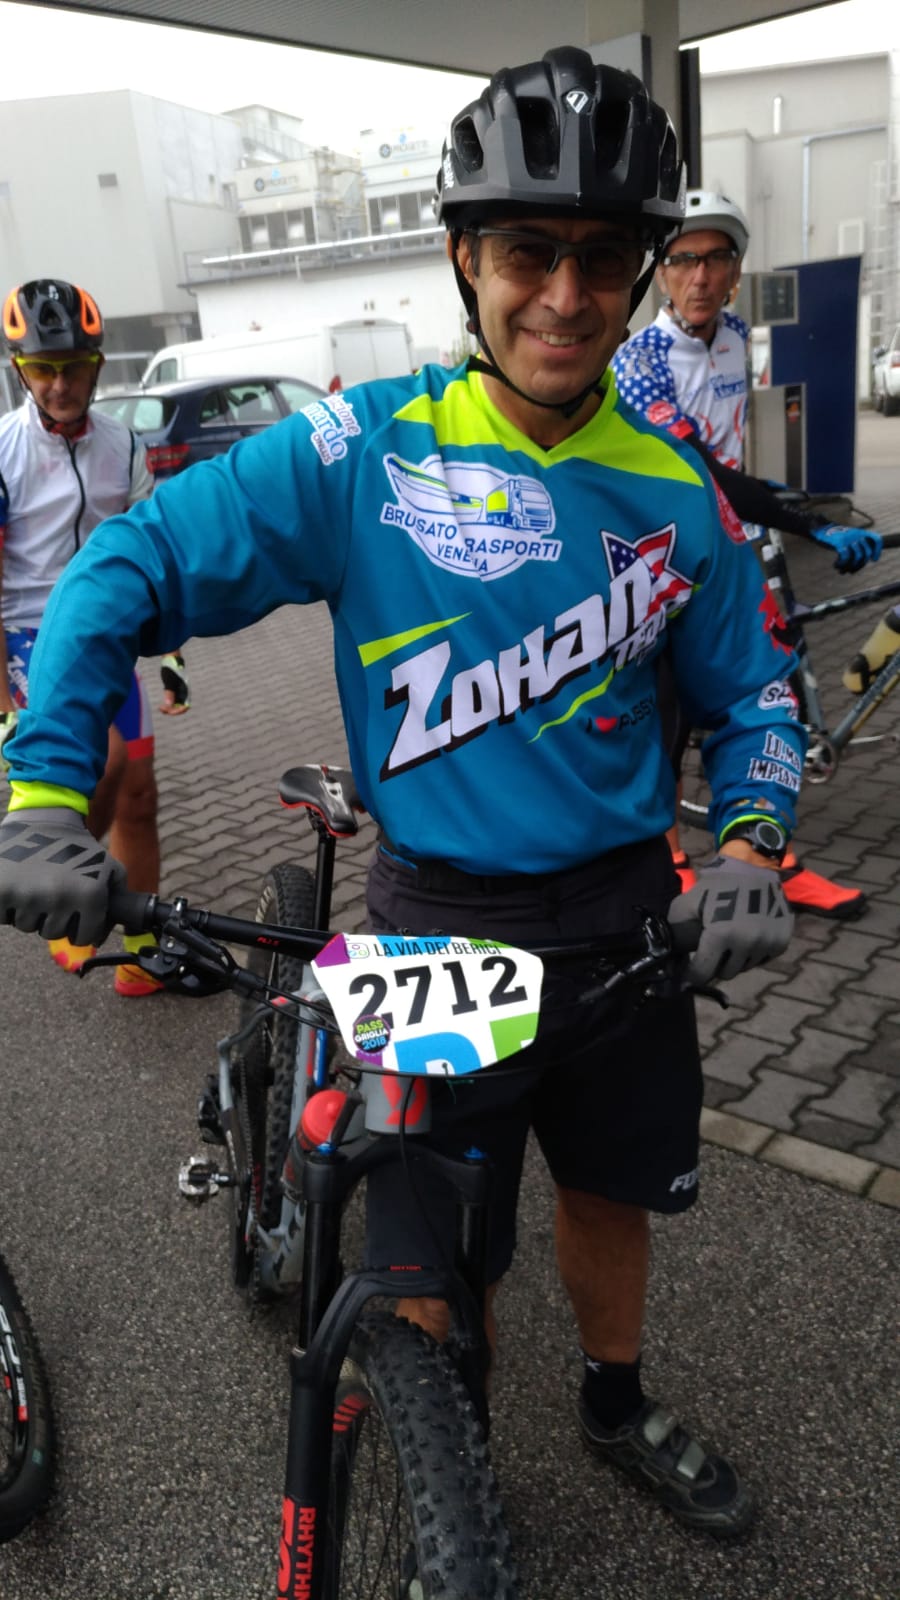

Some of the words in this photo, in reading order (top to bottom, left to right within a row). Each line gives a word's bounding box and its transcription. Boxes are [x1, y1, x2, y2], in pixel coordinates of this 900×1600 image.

[312, 433, 332, 464] ONLUS
[383, 505, 457, 540] BRUSATO
[464, 537, 559, 558] RASPORTI
[437, 543, 489, 572] VENEIA
[703, 883, 788, 924] FOX
[373, 943, 394, 957] LA
[396, 940, 422, 956] VIA
[424, 940, 450, 955] DEI
[450, 942, 502, 956] BERICI
[349, 956, 528, 1029] 2712
[355, 1028, 389, 1042] GRIGLIA
[356, 1019, 384, 1034] PASS
[361, 1036, 387, 1050] 2018
